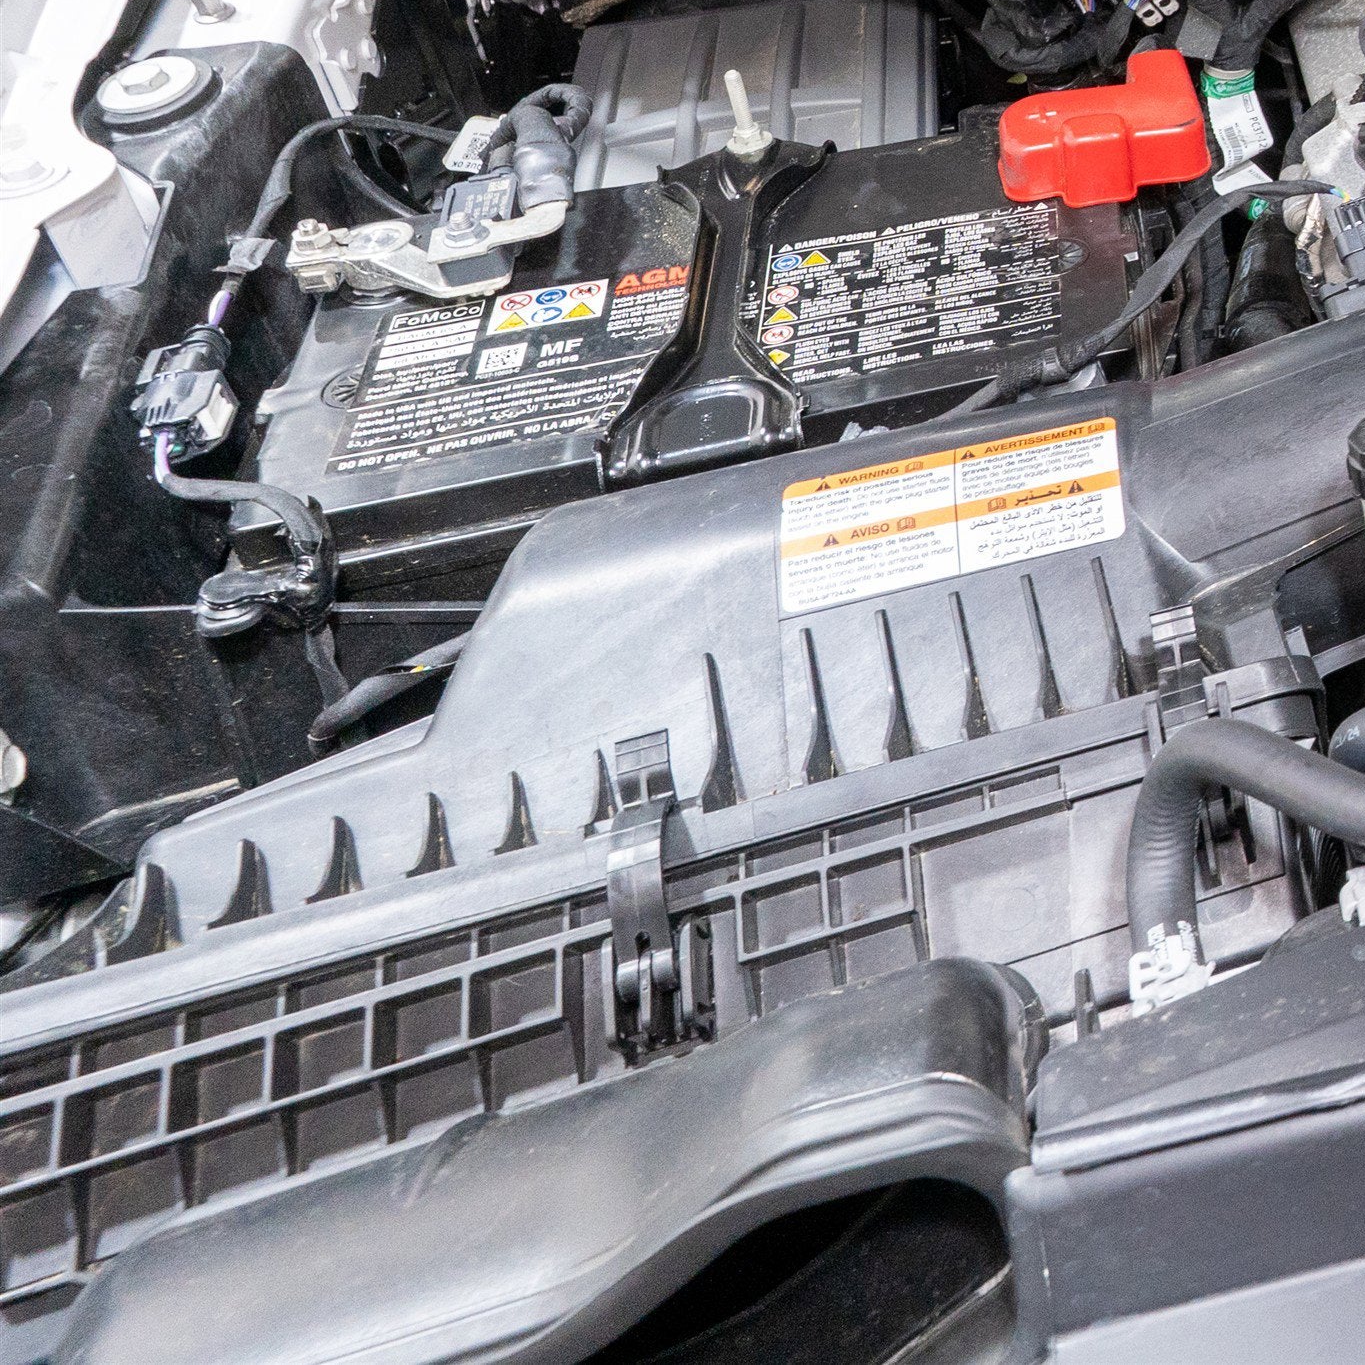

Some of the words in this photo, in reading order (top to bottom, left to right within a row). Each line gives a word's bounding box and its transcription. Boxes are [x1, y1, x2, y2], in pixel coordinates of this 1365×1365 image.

[794, 230, 876, 251] DANGER/POISON
[896, 212, 978, 233] PELIGRO/VENENO
[614, 280, 687, 296] TECHNOLOG
[391, 302, 483, 329] FoMoCo
[539, 334, 583, 359] MF
[335, 458, 358, 472] DO
[355, 453, 385, 468] NOT
[382, 446, 423, 464] OPEN.
[425, 443, 444, 455] NE
[442, 437, 469, 451] PAS
[467, 427, 519, 446] OUVRIR.
[522, 423, 542, 435] NO
[541, 419, 559, 431] LA
[961, 459, 981, 470] Pour
[984, 453, 1013, 465] réduire
[1025, 445, 1050, 456] risque
[1052, 442, 1062, 450] de
[1064, 434, 1104, 448] blessures
[984, 426, 1084, 454] AVERTISSEMENT
[838, 466, 898, 485] WARNING
[961, 465, 989, 477] graves
[992, 462, 1003, 470] ou
[834, 488, 849, 497] risk
[863, 478, 899, 491] possible
[901, 471, 933, 483] serious
[788, 504, 812, 516] injury
[815, 501, 824, 510] or
[884, 493, 903, 504] glow
[845, 547, 853, 556] el
[855, 540, 883, 553] riesgo
[885, 537, 896, 546] de
[898, 529, 934, 544] lesiones
[850, 522, 890, 540] AVISO
[930, 538, 941, 546] de
